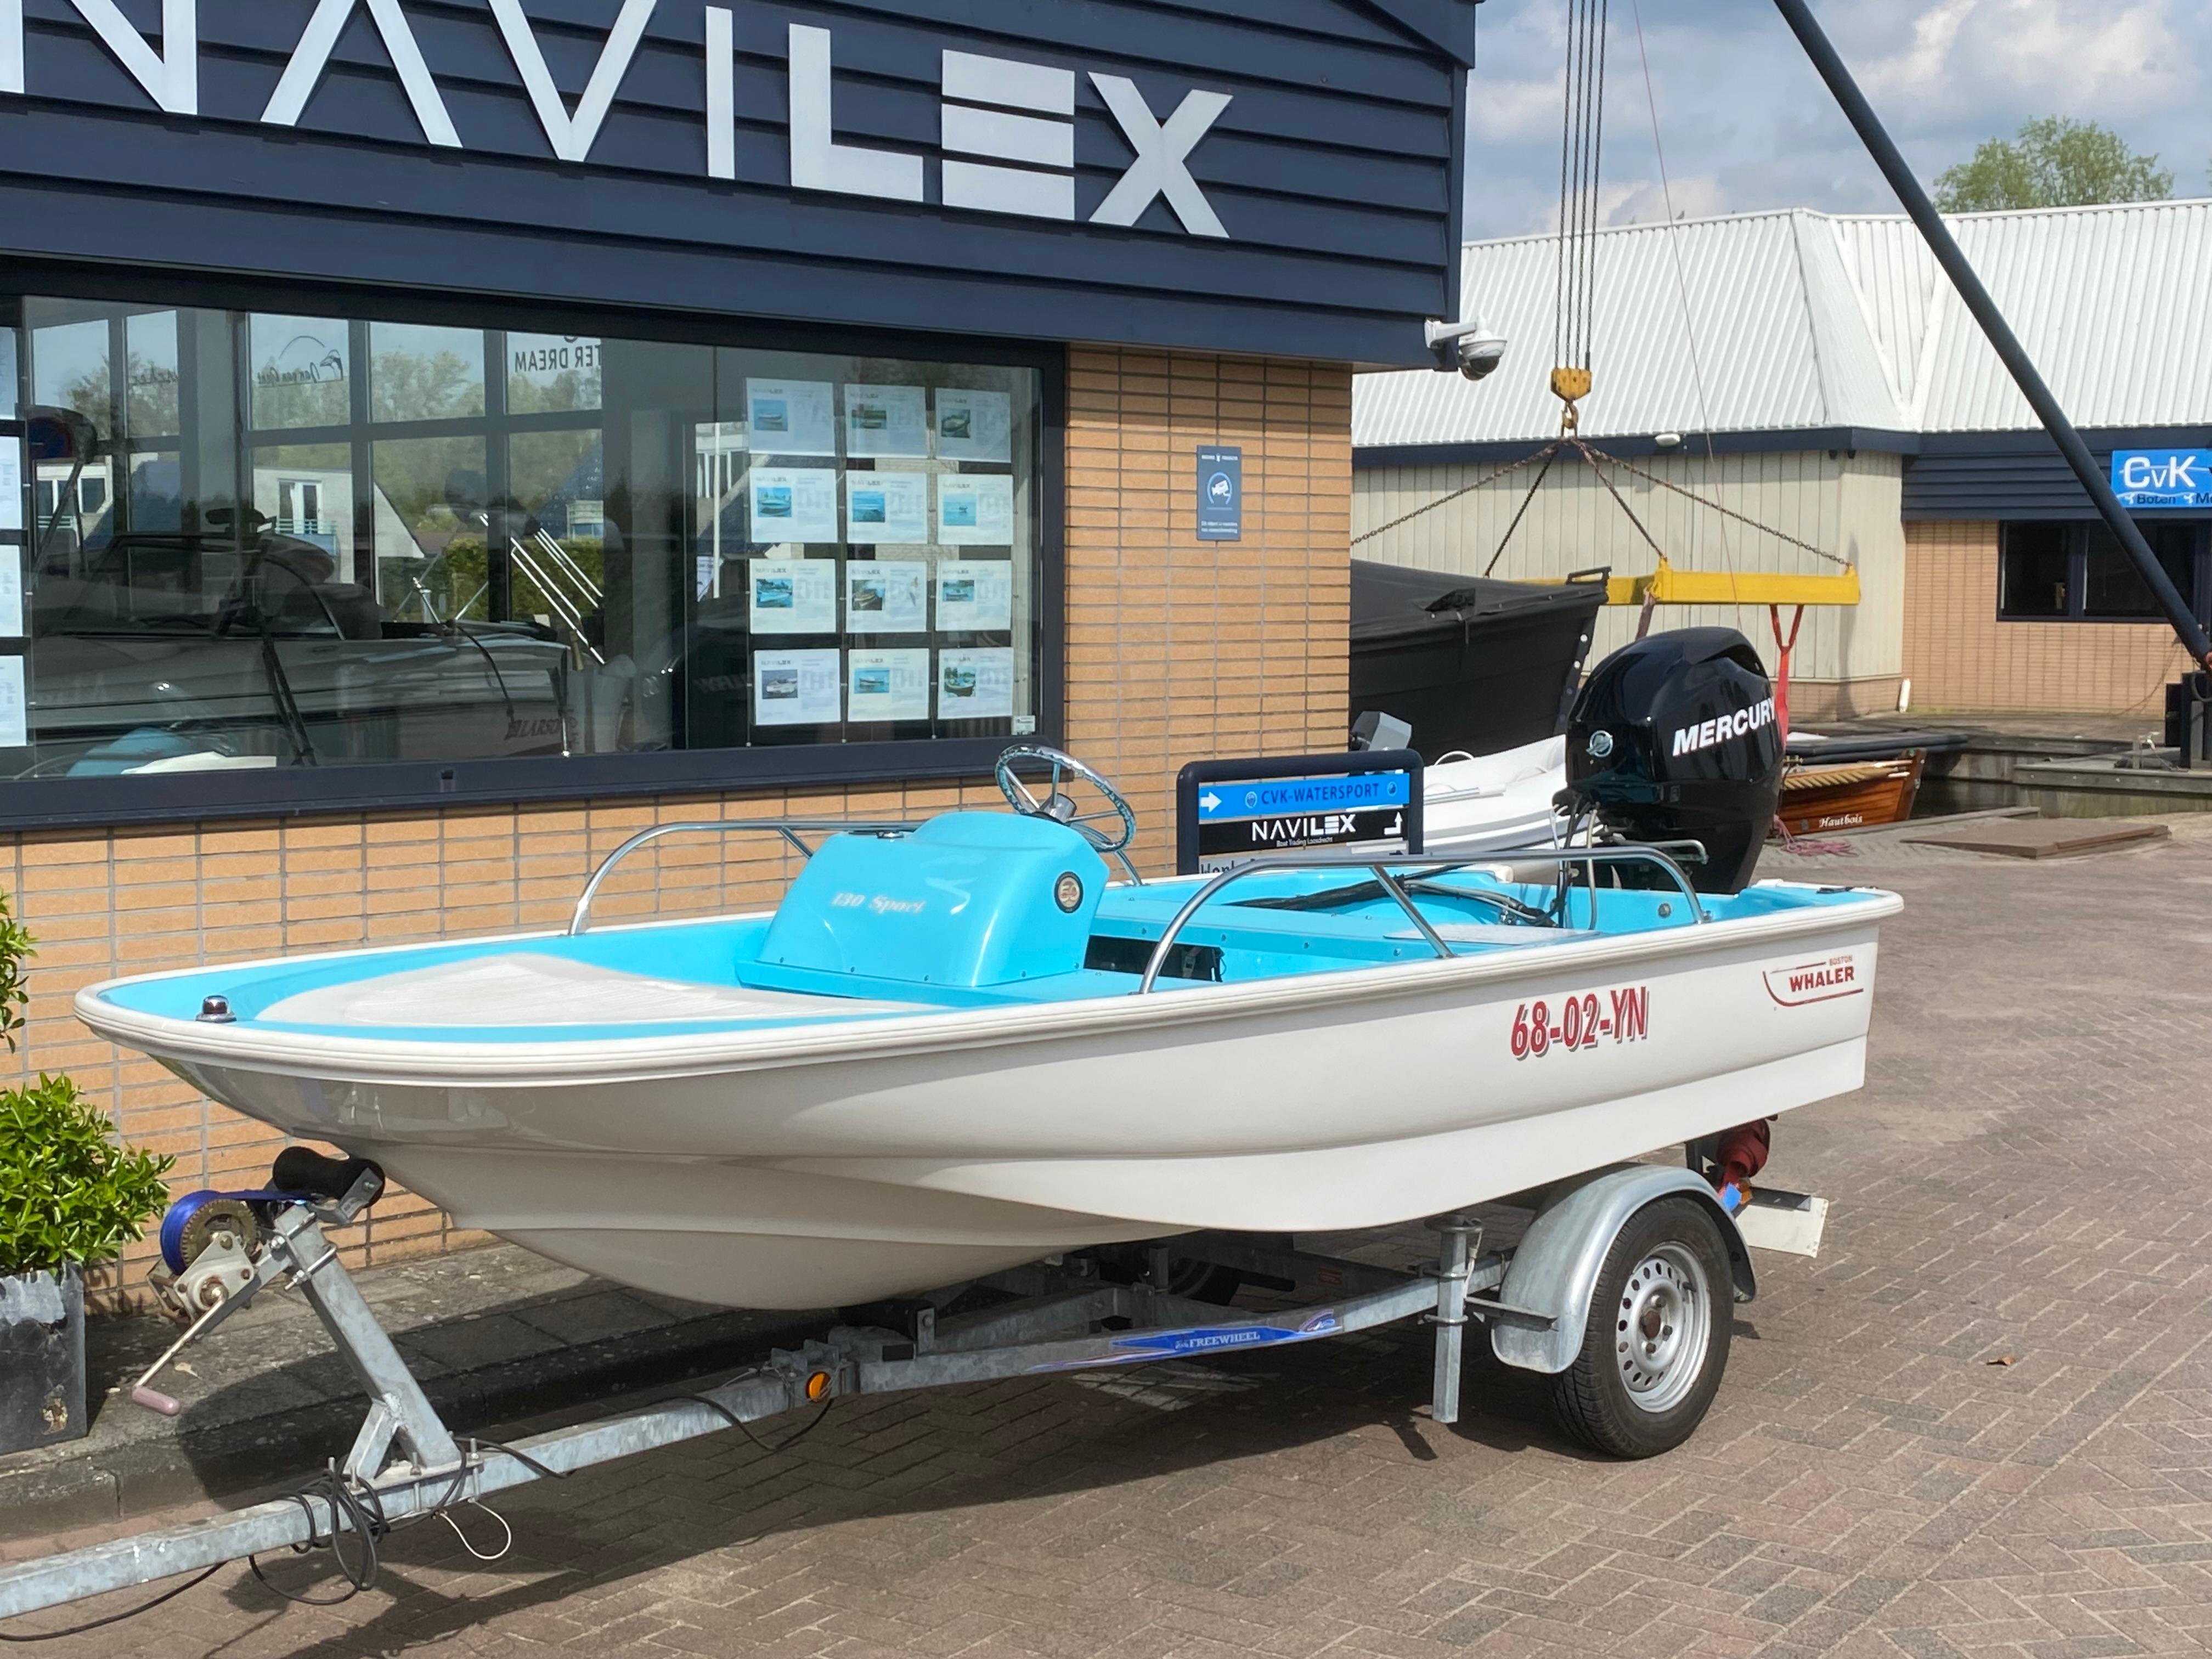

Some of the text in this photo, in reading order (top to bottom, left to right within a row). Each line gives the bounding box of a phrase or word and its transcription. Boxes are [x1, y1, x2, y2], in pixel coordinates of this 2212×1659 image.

[0, 0, 1233, 238] NAVILEX
[2124, 456, 2196, 488] CvK
[2137, 494, 2176, 504] Boten
[1673, 696, 1775, 757] MERCURY
[1261, 783, 1379, 805] CVK-WATERSPORT
[1252, 814, 1356, 841] NAVILEX
[1819, 813, 1863, 828] Hautbois
[1829, 955, 1853, 966] BOSTON
[1789, 966, 1855, 992] WHALER
[1511, 986, 1649, 1060] 68-02-YN
[1189, 1331, 1261, 1348] FREEWHEEL
